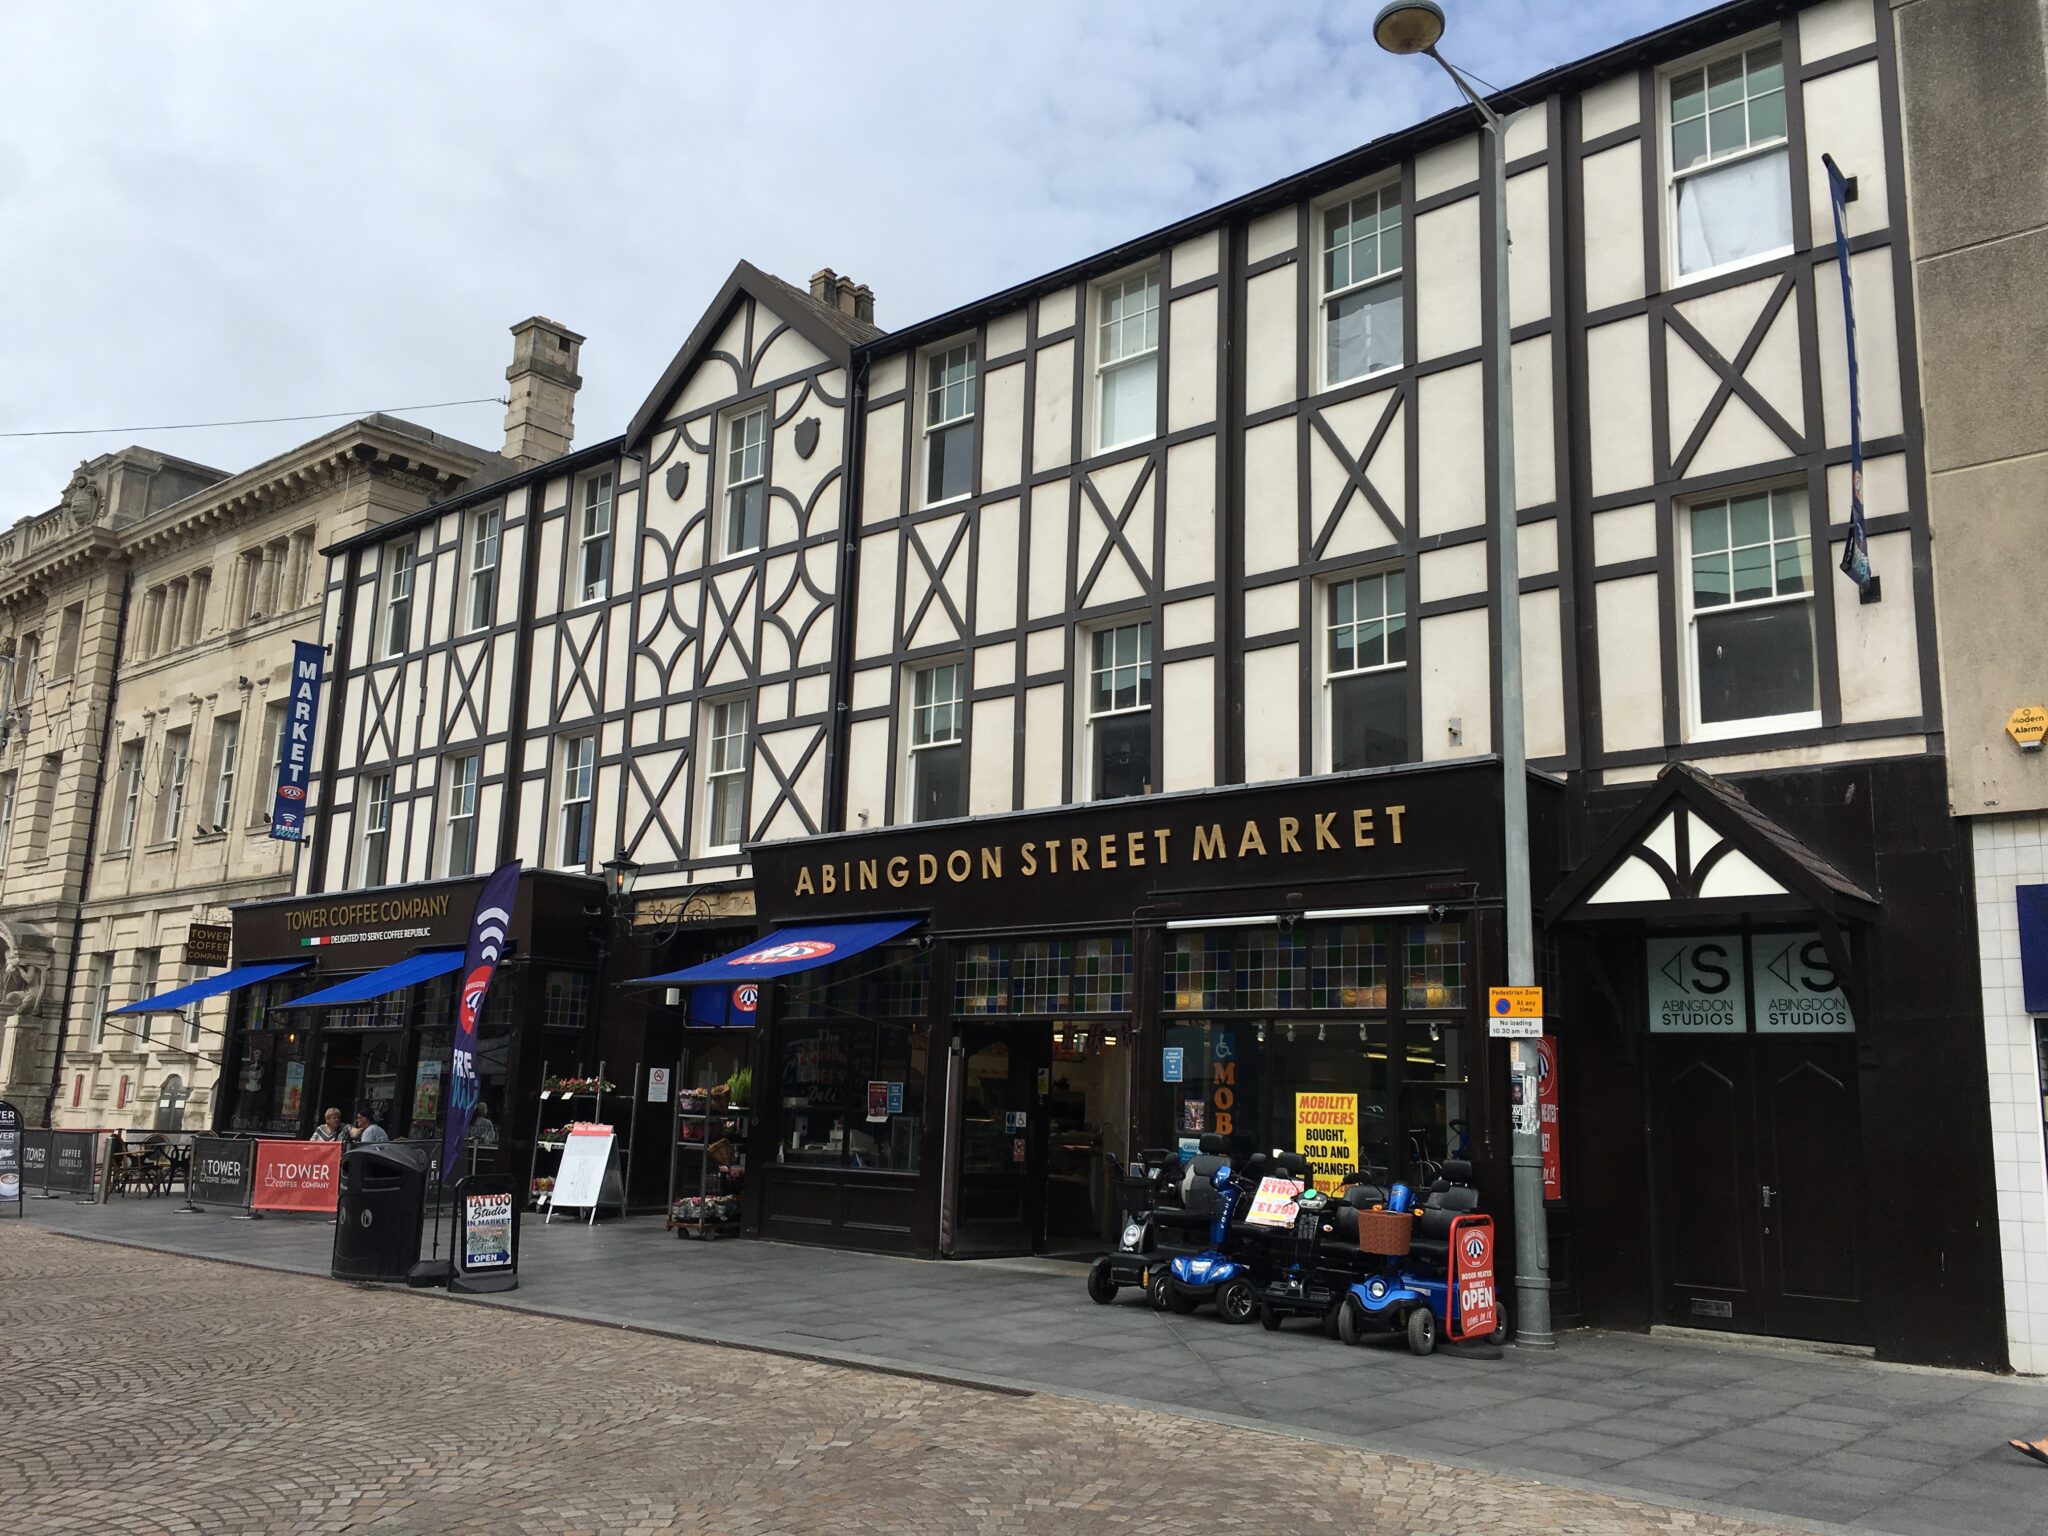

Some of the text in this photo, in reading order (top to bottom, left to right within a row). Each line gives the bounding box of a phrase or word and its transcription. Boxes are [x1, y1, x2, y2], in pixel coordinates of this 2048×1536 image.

[289, 660, 317, 782] MARKET
[2015, 726, 2043, 734] Alarms
[795, 805, 1406, 896] ABINGDON STREET MARKET
[286, 895, 449, 931] TOWER COFFEE COMPANY
[191, 929, 229, 941] TOWER
[330, 927, 431, 944] DELIGHTED TO SERVE COFFEE REPUBLIC
[189, 940, 228, 952] COFFEE
[188, 951, 228, 962] COMPANY
[1662, 1000, 1733, 1012] ABINGDON
[1768, 998, 1846, 1011] ABINGDON
[1662, 1013, 1734, 1026] STUDIOS
[1769, 1012, 1846, 1025] STUDIOS
[1213, 1062, 1236, 1135] MOB
[1299, 1095, 1354, 1109] MOBILITY
[1298, 1111, 1354, 1125] SCOOTERS
[1306, 1129, 1347, 1143] BOUGHT,
[26, 1147, 46, 1162] TOWER
[62, 1149, 81, 1158] COFFEE
[1304, 1145, 1350, 1159] SOLD AND
[208, 1159, 241, 1177] TOWER
[277, 1163, 330, 1181] TOWER
[1309, 1162, 1356, 1175] CHANGED
[206, 1176, 220, 1184] COFFEE
[275, 1180, 330, 1189] COFFEE COMPANY
[467, 1193, 511, 1208] TATTOO
[472, 1207, 508, 1219] Studio
[478, 1218, 511, 1226] MARKET
[474, 1253, 498, 1262] OPEN
[1461, 1269, 1492, 1281] INDOOR HEATED
[1462, 1287, 1494, 1311] OPEN
